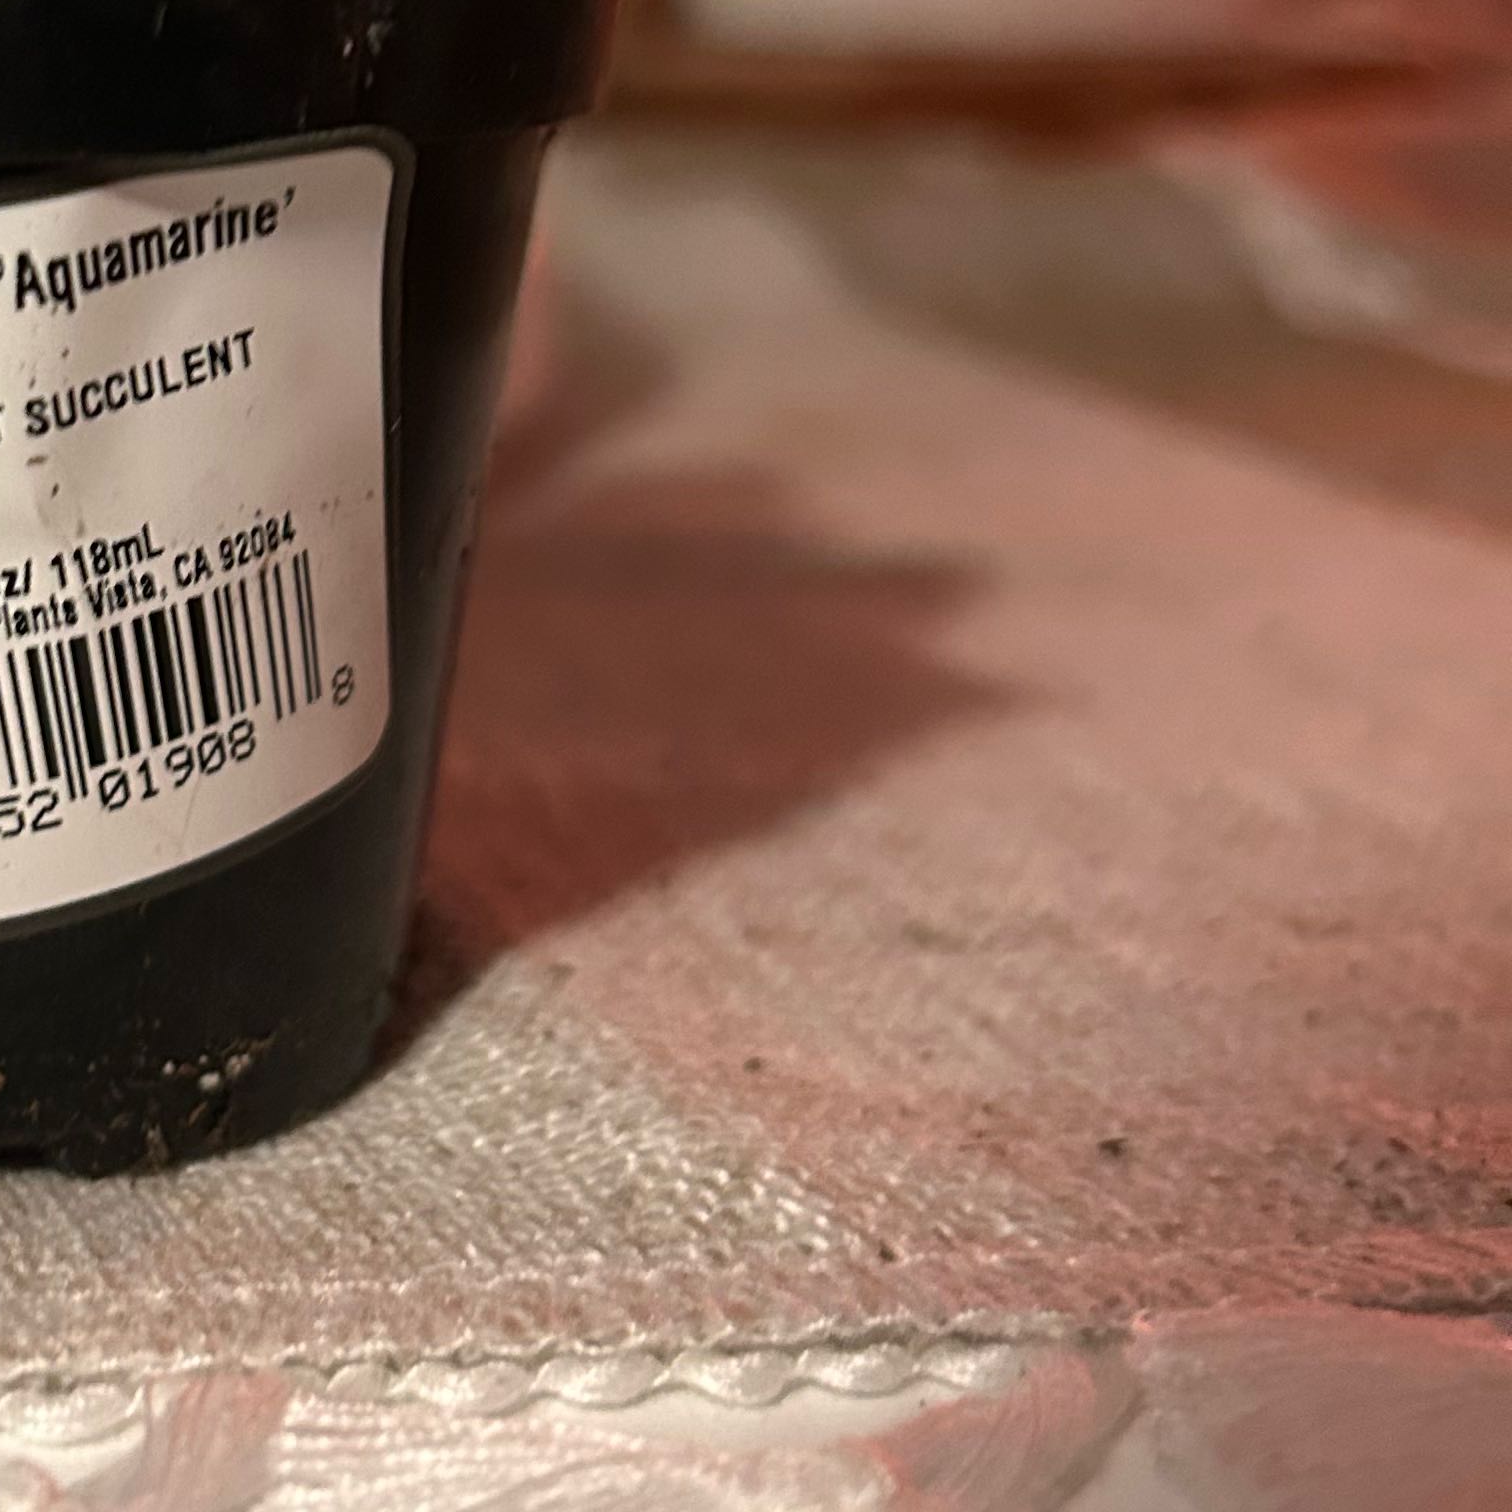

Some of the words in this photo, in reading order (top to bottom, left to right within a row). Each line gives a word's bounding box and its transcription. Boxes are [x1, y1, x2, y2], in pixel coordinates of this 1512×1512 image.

[24, 327, 257, 438] SUCCULENT
[50, 522, 165, 586] 118mL
[88, 570, 168, 619] Vista,
[174, 552, 214, 588] CA
[219, 510, 297, 570] 92084
[98, 719, 258, 813] 01908
[330, 663, 356, 706] 8
